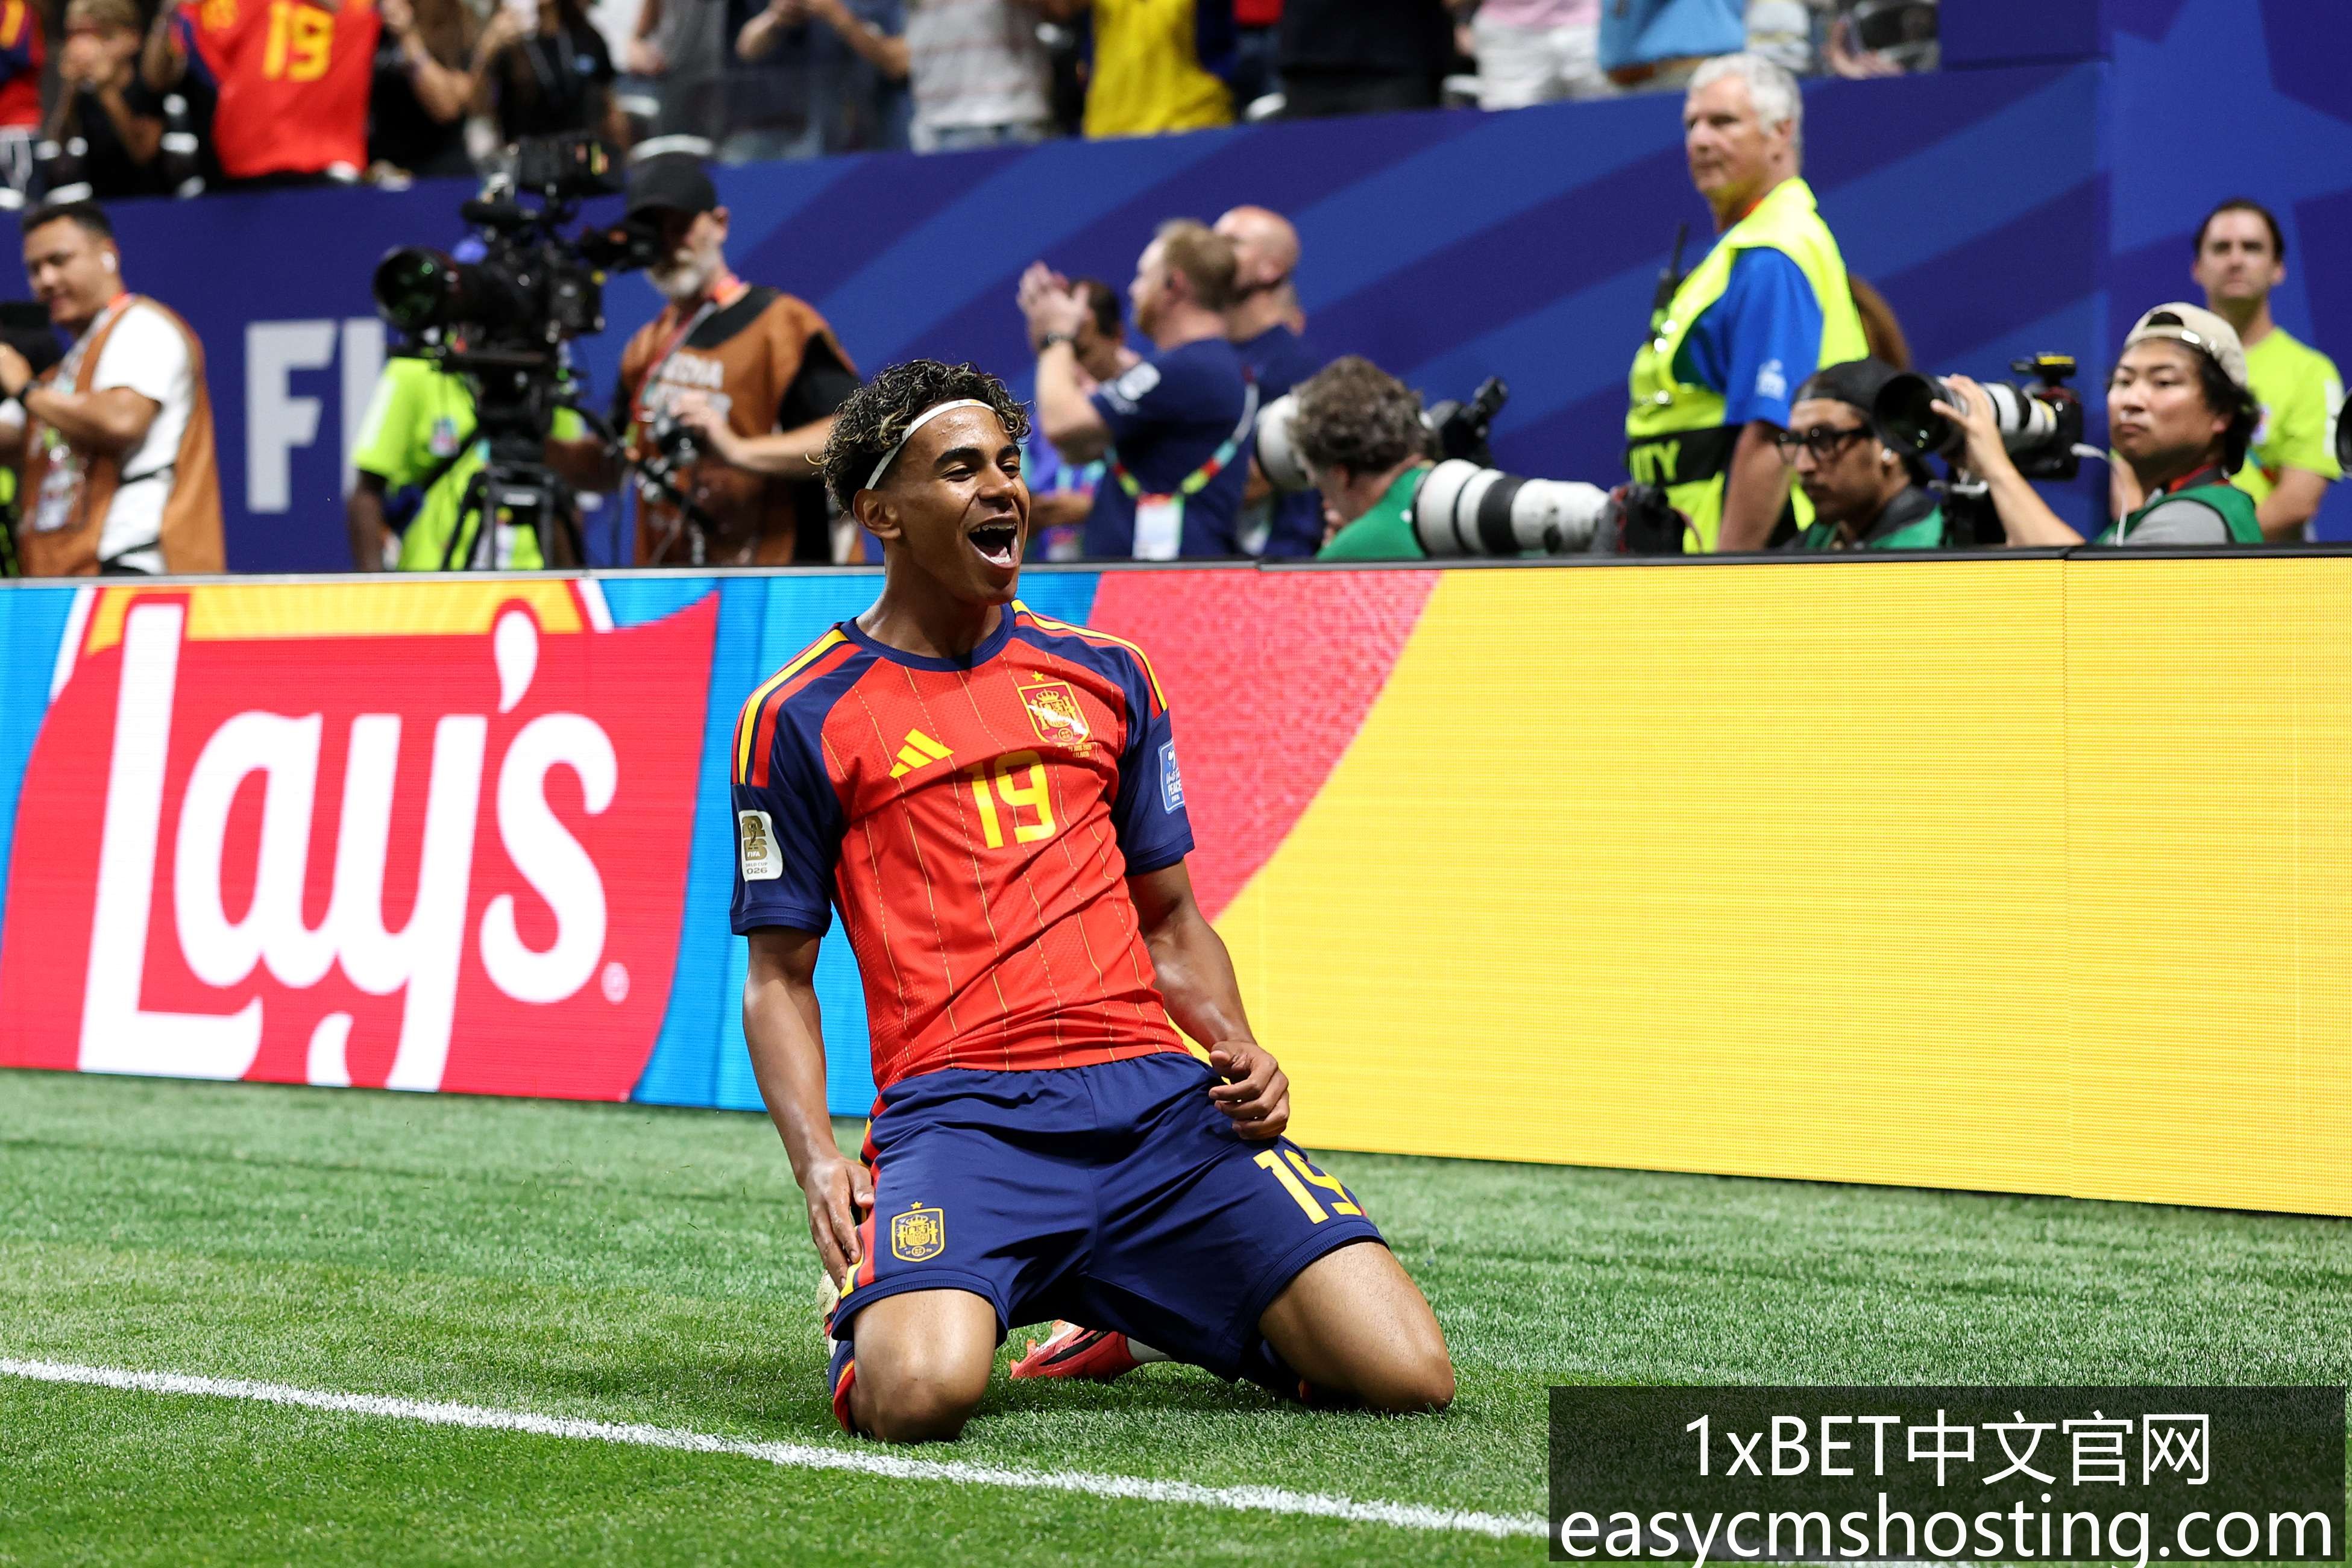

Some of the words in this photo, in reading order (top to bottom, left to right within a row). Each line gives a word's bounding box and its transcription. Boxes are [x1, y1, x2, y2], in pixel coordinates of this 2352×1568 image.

[264, 1, 335, 81] 19
[245, 318, 387, 514] FI
[963, 749, 1056, 849] 19
[1168, 779, 1182, 797] PEACE
[78, 603, 617, 1092] Lay's
[1253, 1149, 1363, 1225] 19
